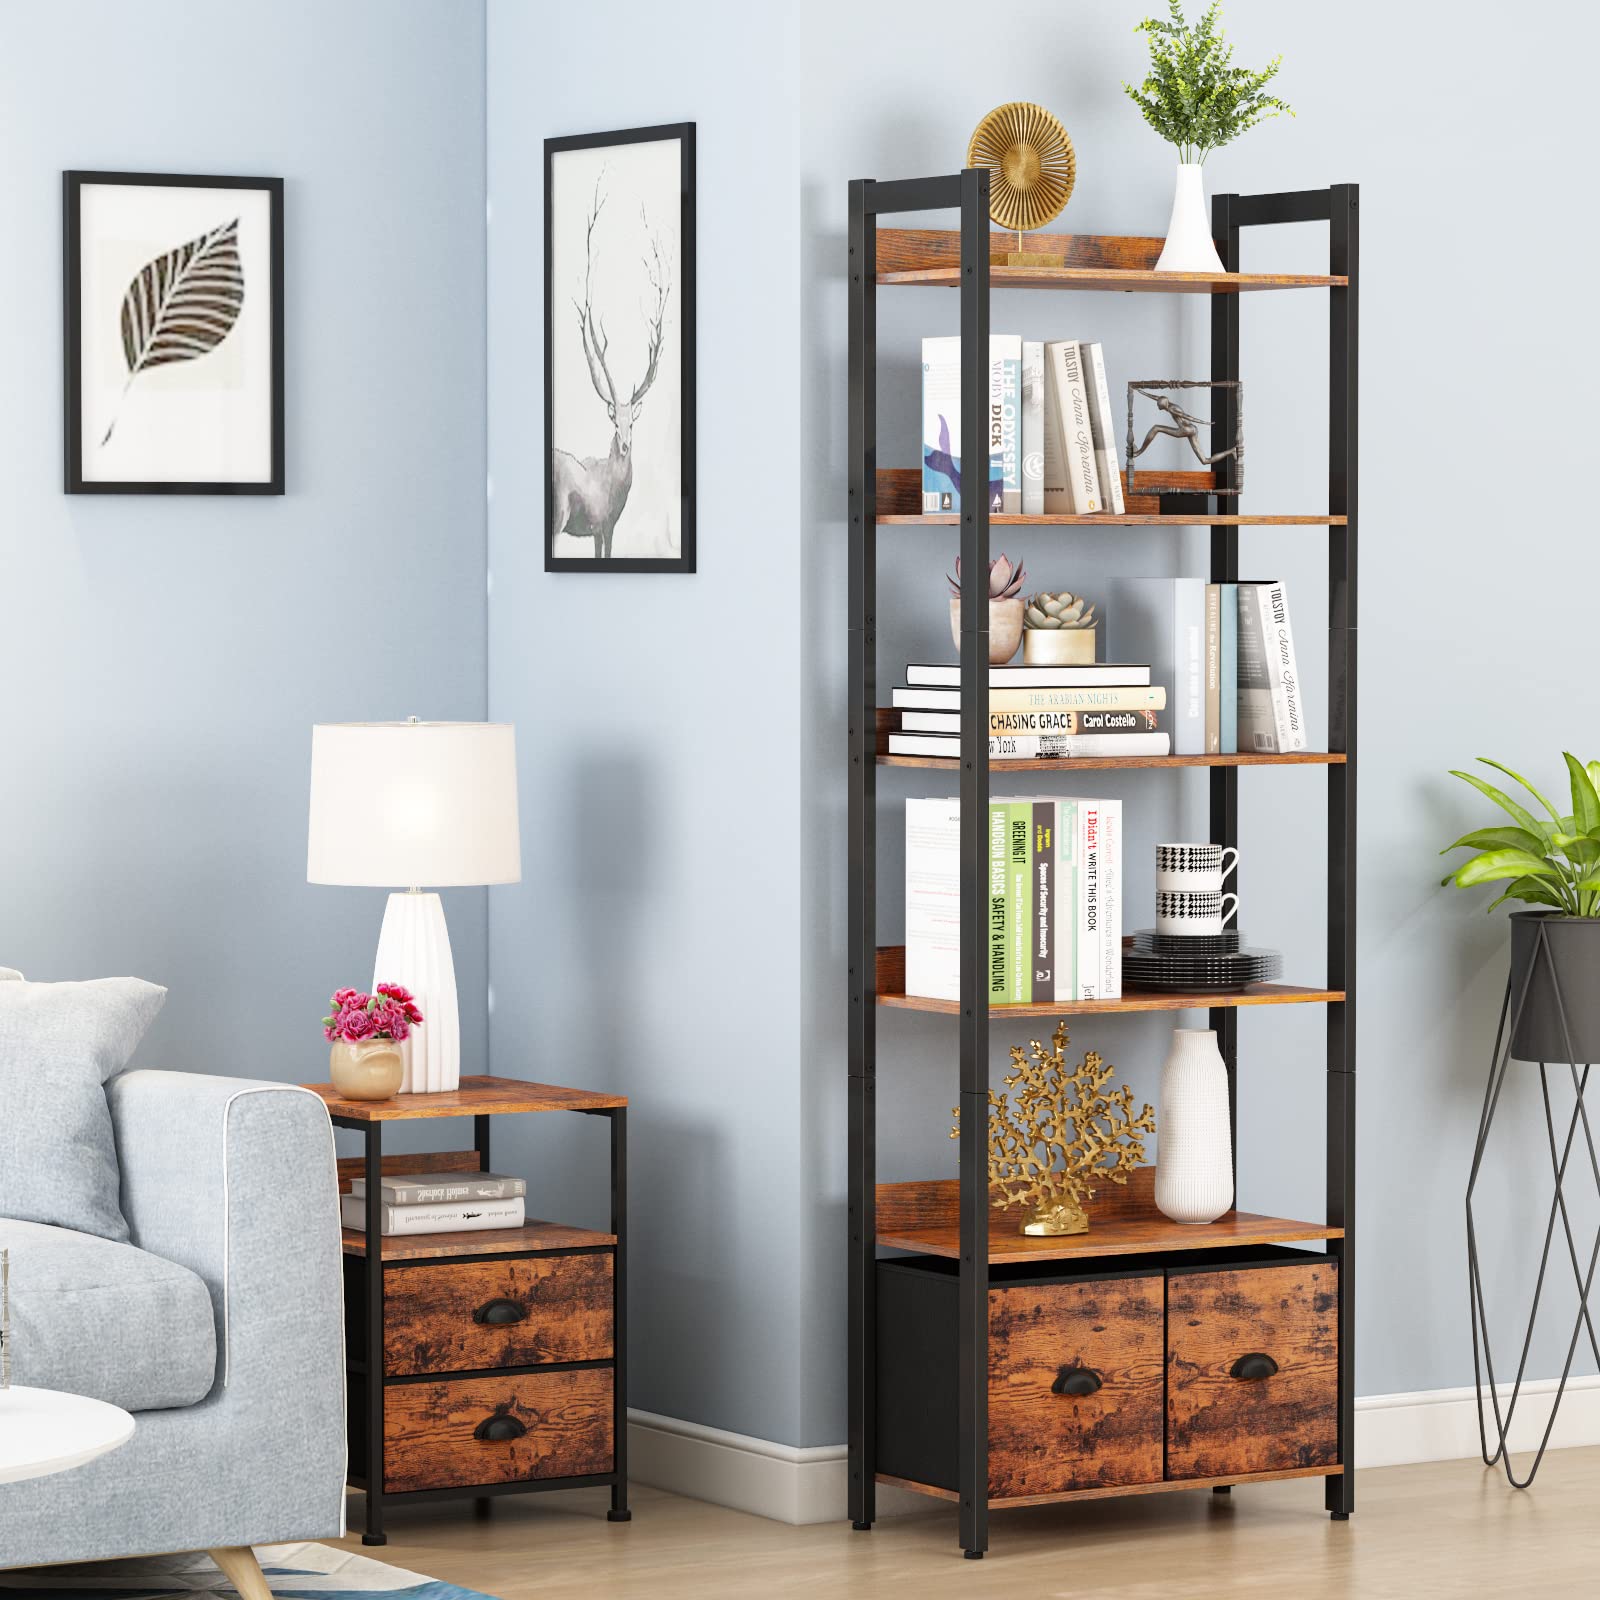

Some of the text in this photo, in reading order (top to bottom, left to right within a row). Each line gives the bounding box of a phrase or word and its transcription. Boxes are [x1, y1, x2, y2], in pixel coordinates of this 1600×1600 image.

[1064, 345, 1079, 383] TOLSTOY
[991, 361, 1002, 447] MOBY DICK
[1003, 364, 1016, 486] THE ODYSSEY
[1071, 388, 1094, 494] Anna Karenina
[1270, 588, 1285, 624] TOLSTOY
[1278, 629, 1290, 665] Anna
[1209, 645, 1217, 689] Revolution
[1029, 692, 1119, 706] THE ARABIAN NIGHTS
[1280, 671, 1299, 732] Karenina
[990, 713, 1072, 730] CHASING GRACE
[1083, 713, 1104, 728] Carol
[1105, 713, 1136, 728] Costello
[997, 736, 1017, 754] York
[991, 811, 1006, 858] HANDGUN
[1012, 821, 1026, 855] GREENING
[1087, 817, 1098, 850] Didn't
[991, 861, 1006, 895] BASICS
[1039, 862, 1048, 884] Spaces
[1087, 852, 1097, 880] WRITE
[1038, 891, 1048, 916] Security
[1087, 883, 1097, 903] THIS
[991, 897, 1005, 932] SAFETY
[1040, 916, 1048, 928] and
[1087, 905, 1097, 931] BOOK
[1038, 928, 1048, 958] Insecurity
[991, 944, 1005, 992] HANDLING
